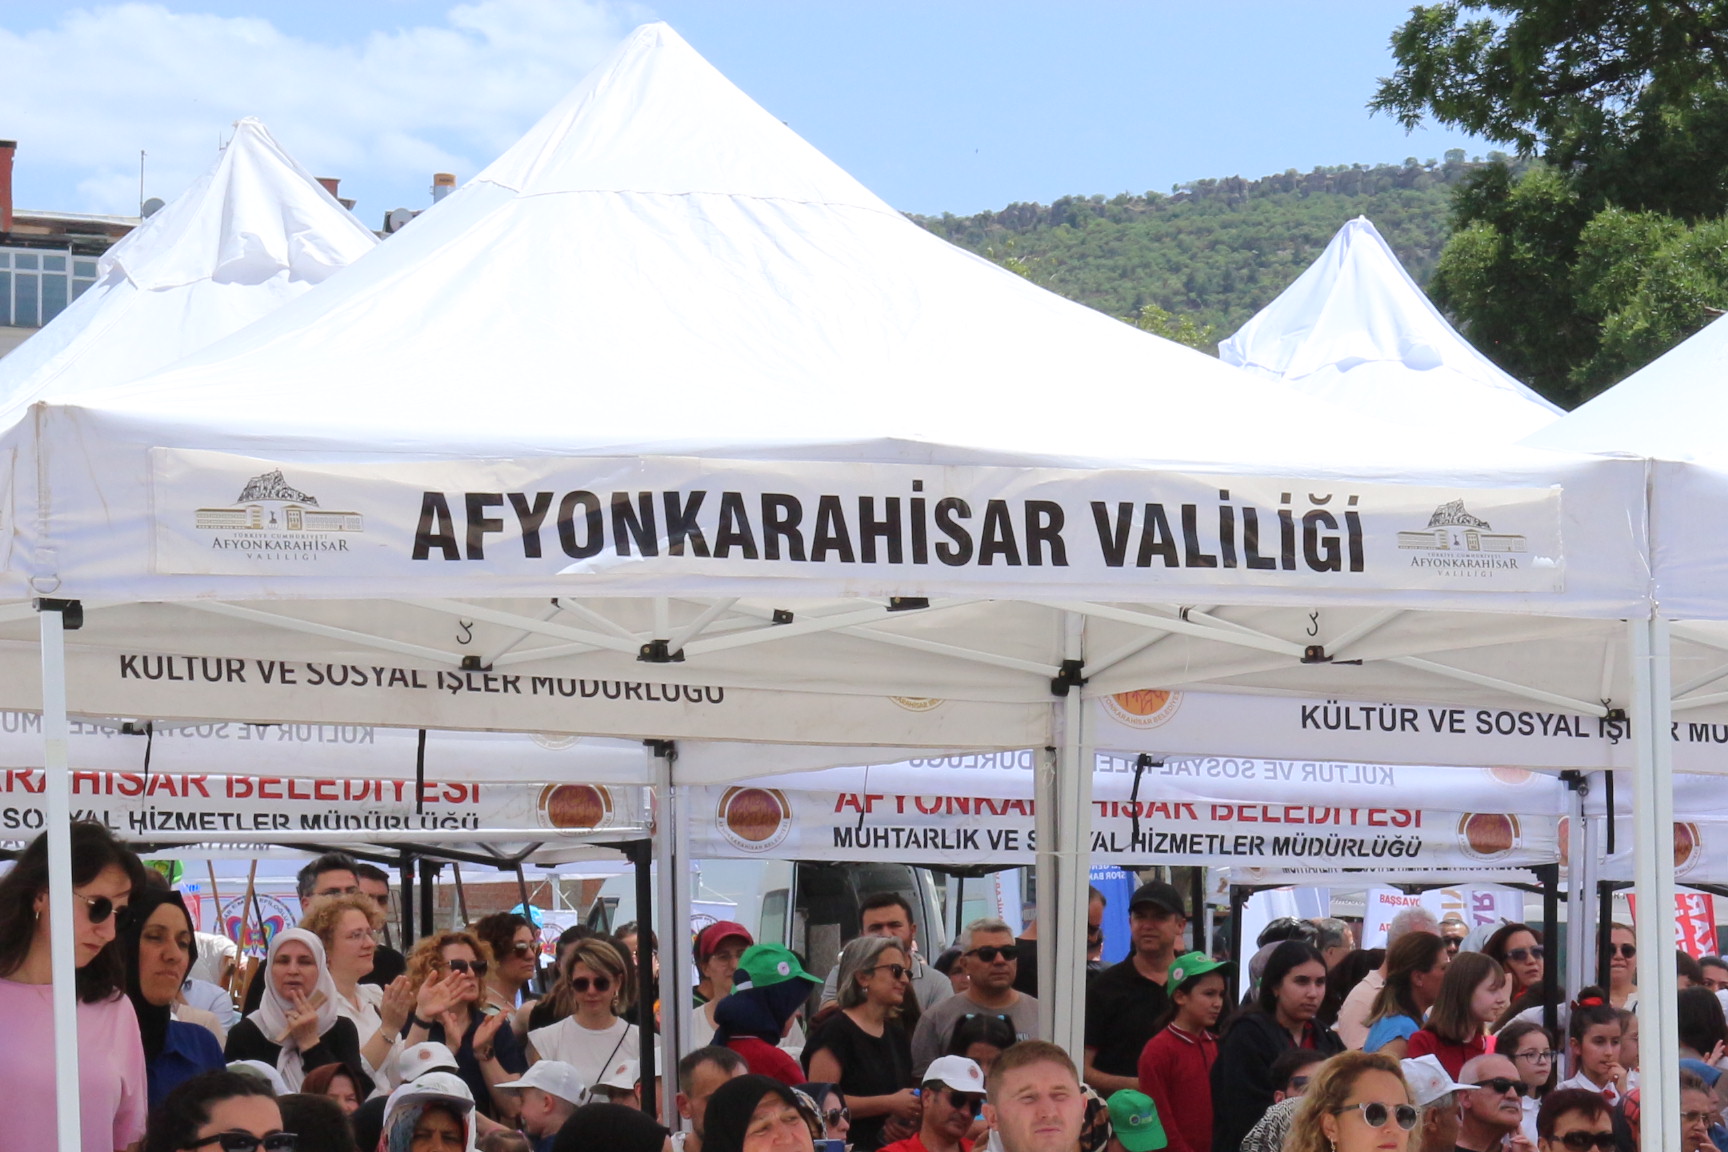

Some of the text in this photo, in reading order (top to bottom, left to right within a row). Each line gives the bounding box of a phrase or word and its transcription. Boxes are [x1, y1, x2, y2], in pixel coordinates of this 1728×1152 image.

[411, 479, 1365, 573] AFYONKARAHİSAR VALİLİĞİ
[212, 536, 350, 553] AFYONKARAHİSAR
[1302, 701, 1420, 733] KÜLTÜR
[1428, 708, 1467, 734] VE
[1476, 711, 1591, 739] SOSYAL
[833, 826, 978, 850] MUHTARLIK
[987, 829, 1018, 851] VE
[1131, 827, 1265, 857] HİZMETLER
[1272, 832, 1422, 858] MÜDÜRLÜĞÜ
